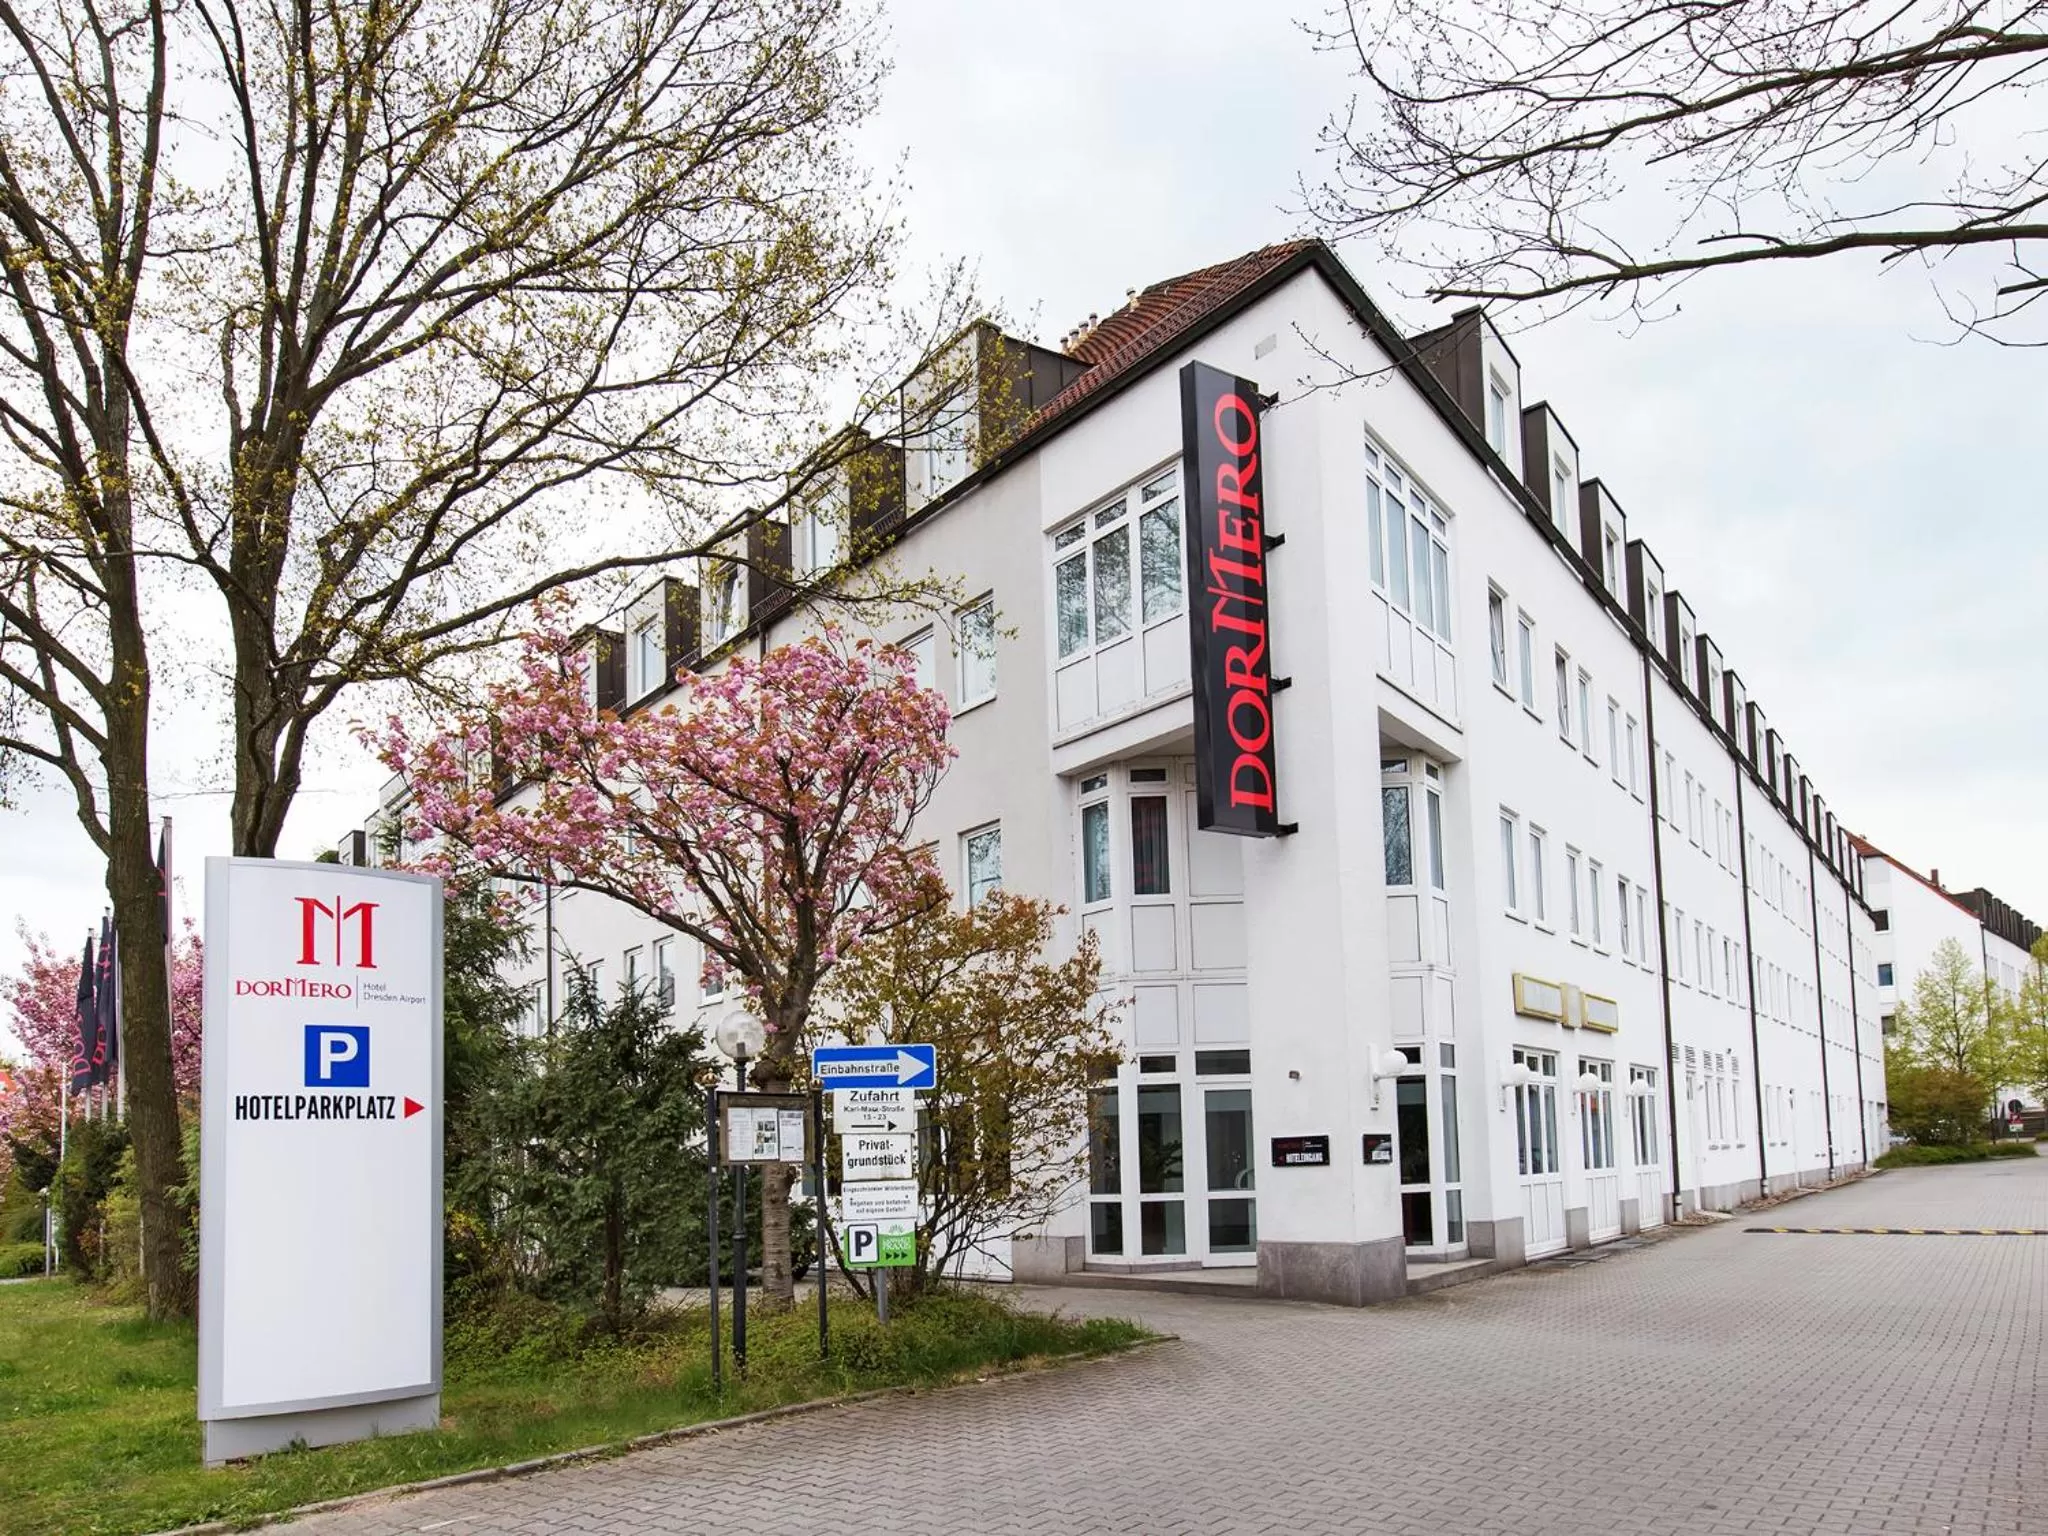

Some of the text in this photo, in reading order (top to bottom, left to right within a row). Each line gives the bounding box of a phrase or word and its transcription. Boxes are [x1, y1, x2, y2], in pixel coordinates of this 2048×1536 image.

[1207, 391, 1274, 814] DORMERO
[363, 982, 386, 992] Hotel
[363, 991, 426, 1005] Dresden Airport
[320, 1031, 358, 1079] P
[820, 1063, 900, 1075] Einbahnstraße
[850, 1090, 900, 1102] Zufahrt
[235, 1095, 396, 1120] HOTELPARKPLATZ
[858, 1139, 894, 1151] Privat-
[847, 1154, 906, 1169] grundstück
[854, 1230, 873, 1257] P
